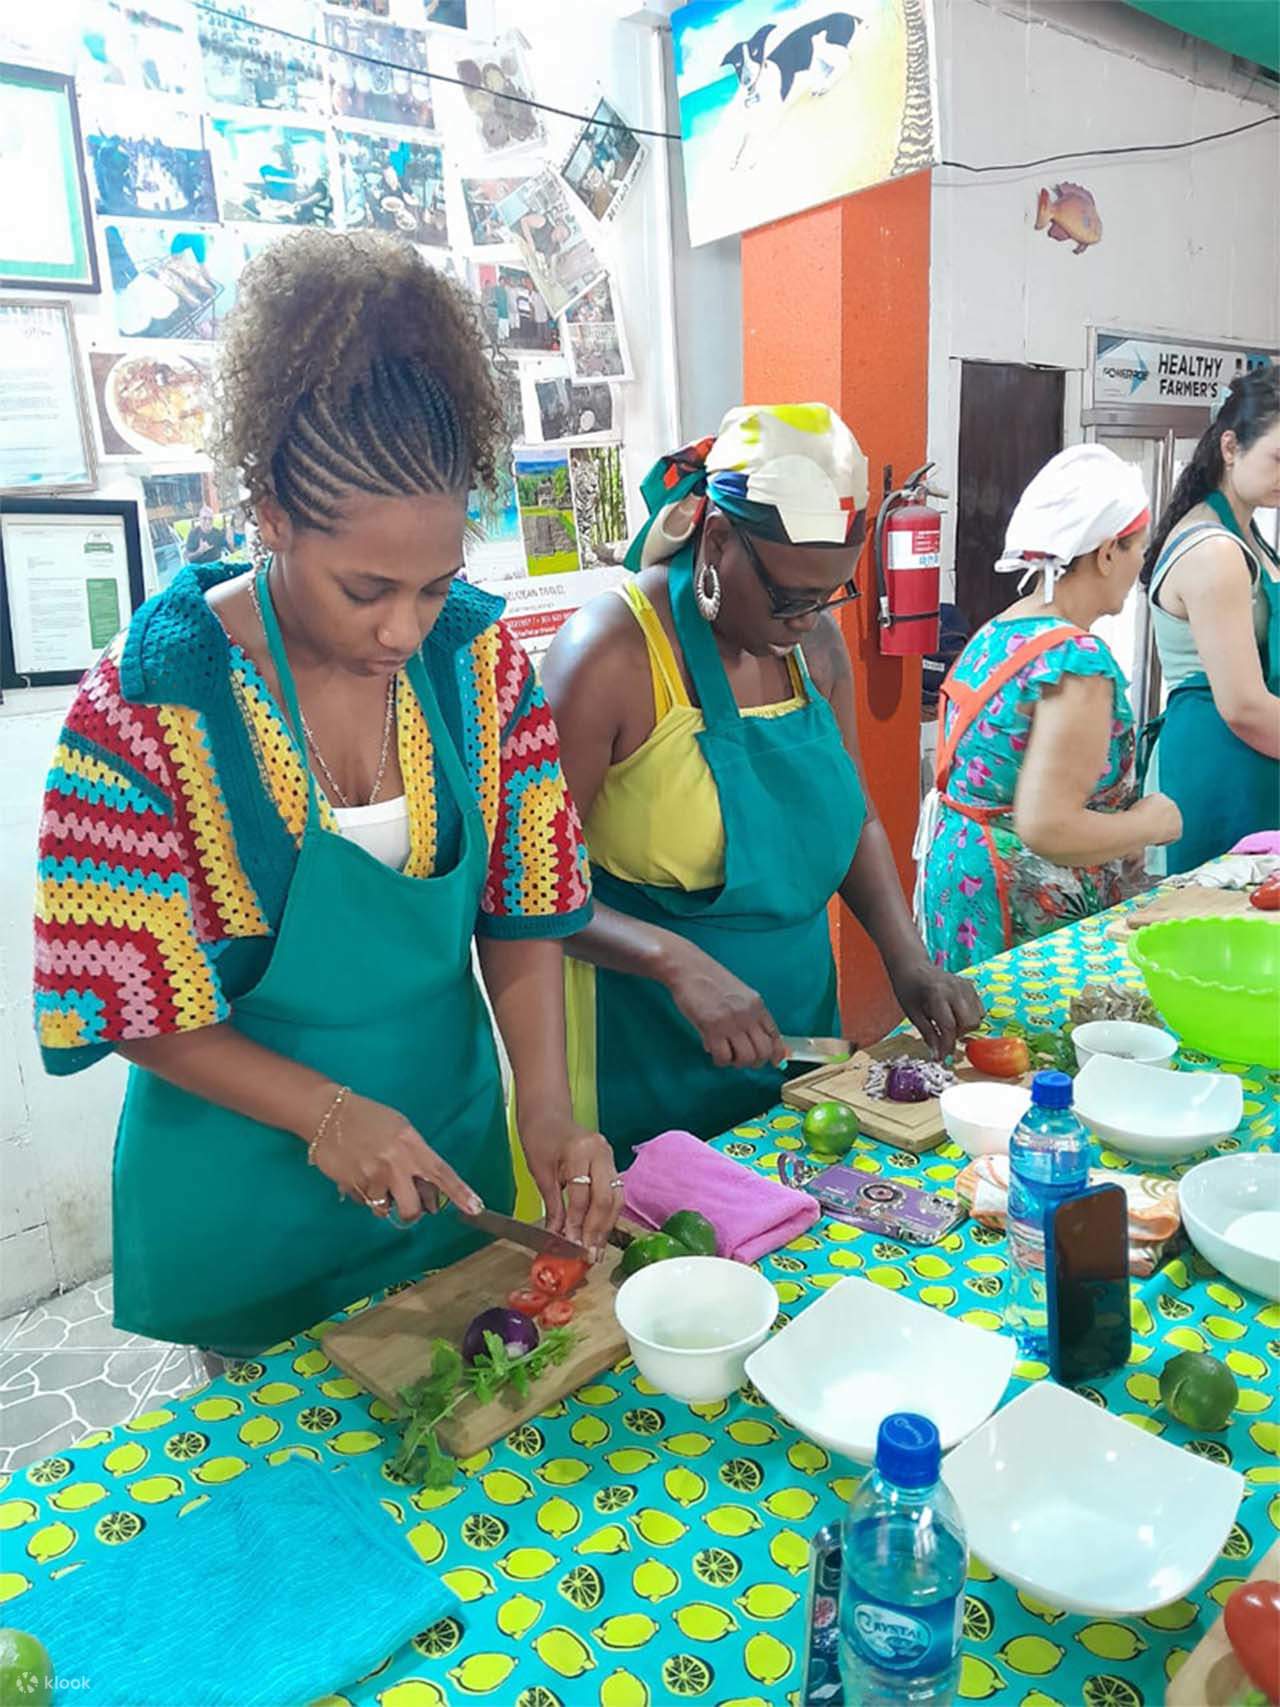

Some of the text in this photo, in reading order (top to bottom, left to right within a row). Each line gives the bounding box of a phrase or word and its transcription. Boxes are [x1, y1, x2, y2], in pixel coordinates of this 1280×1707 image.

[1158, 353, 1223, 378] HEALTHY
[1160, 379, 1218, 398] FARMER'S
[857, 1611, 922, 1638] CRYSTAL
